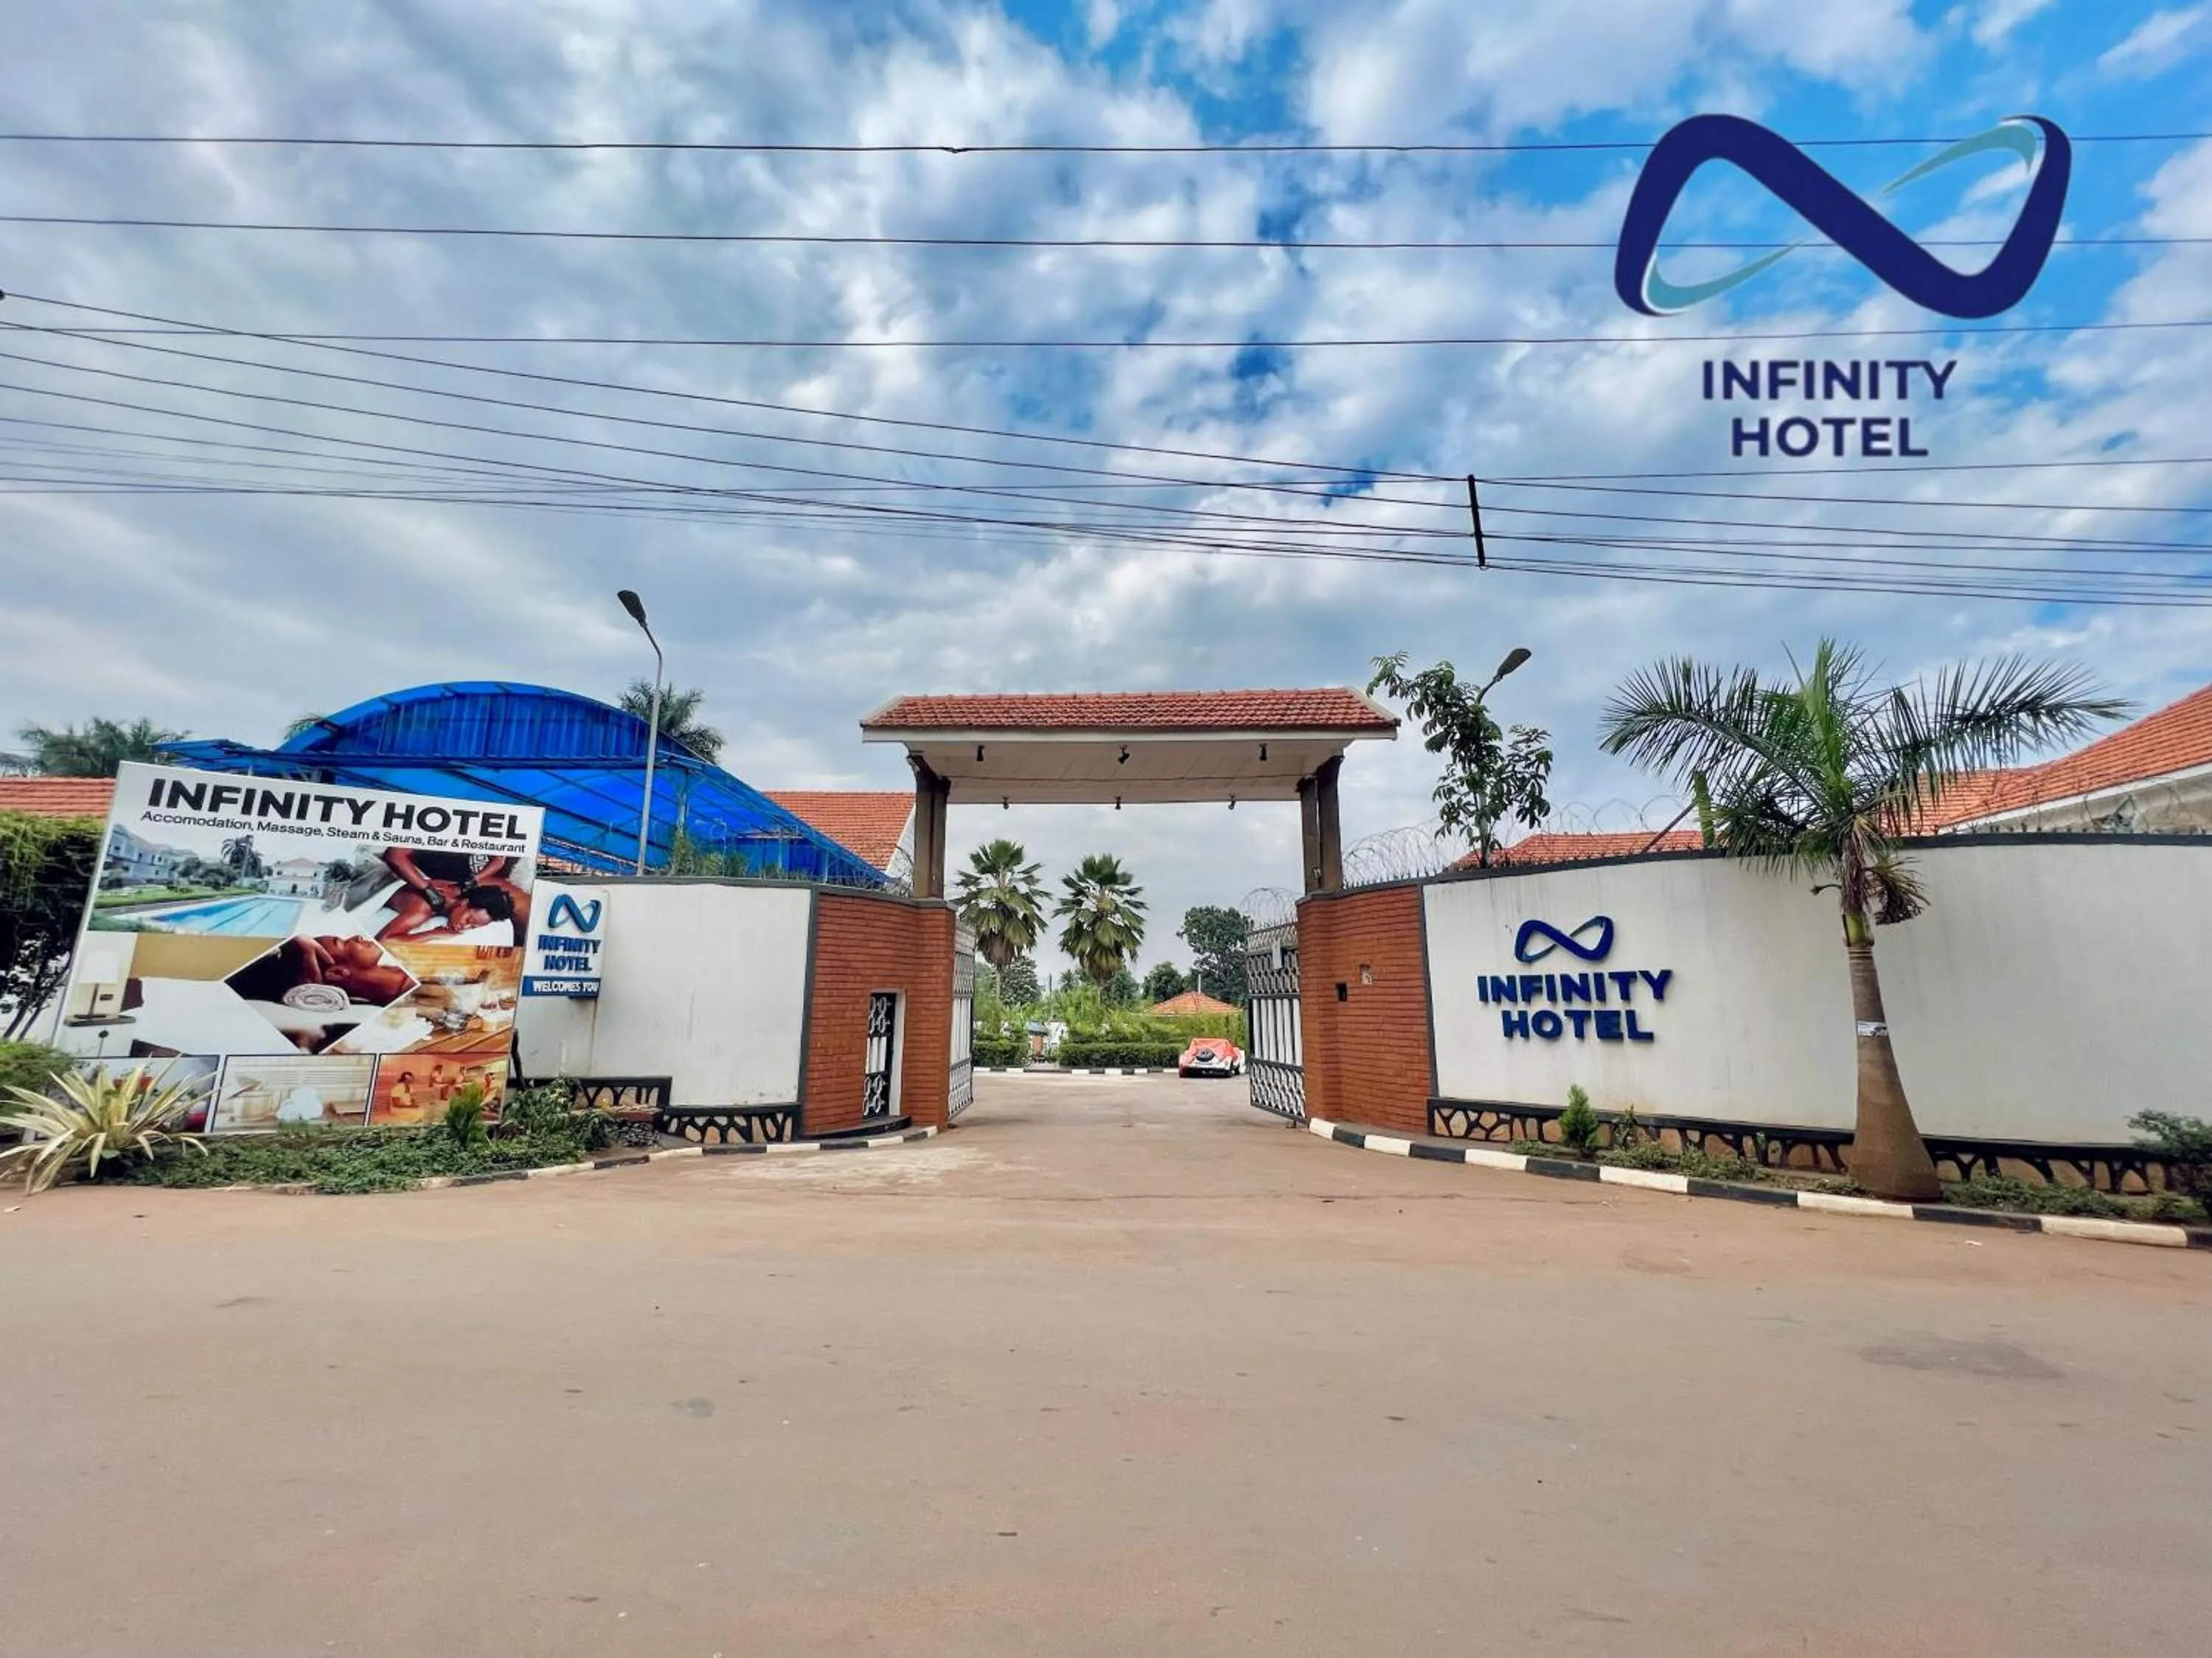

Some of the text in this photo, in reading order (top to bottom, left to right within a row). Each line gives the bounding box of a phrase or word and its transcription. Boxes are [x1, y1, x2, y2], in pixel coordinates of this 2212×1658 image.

[147, 778, 527, 840] INFINITY HOTEL
[141, 811, 526, 853] Accomodation, Massage, Steam & Sauna, Bar & Restaurant
[538, 934, 602, 954] INFINITY
[543, 954, 593, 971] HOTEL
[532, 979, 599, 992] WELCOMES YOU
[1477, 969, 1673, 1003] INFINITY
[1500, 1009, 1655, 1041] HOTEL
